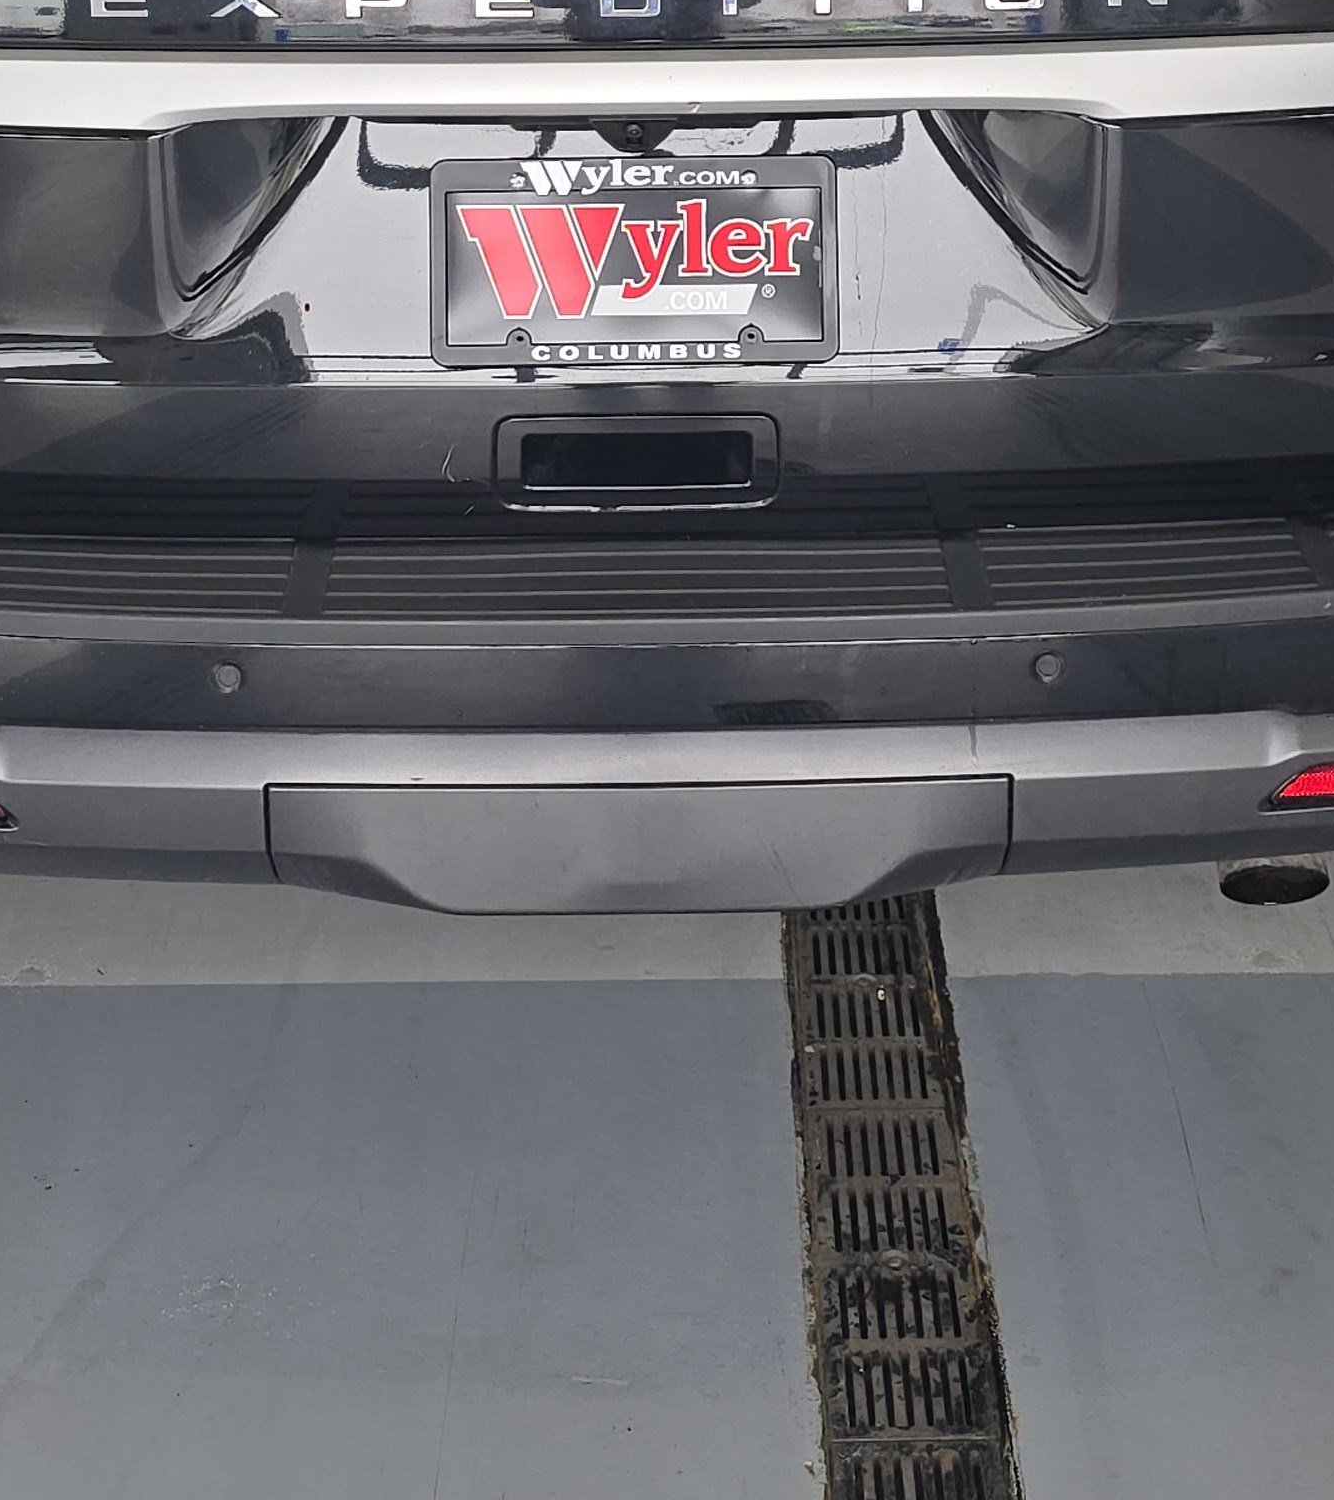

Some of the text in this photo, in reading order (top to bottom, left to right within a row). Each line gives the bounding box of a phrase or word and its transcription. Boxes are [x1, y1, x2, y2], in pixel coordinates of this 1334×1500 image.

[455, 198, 814, 320] Wyler
[663, 290, 728, 312] .COM
[530, 343, 742, 361] COLUMBUS
